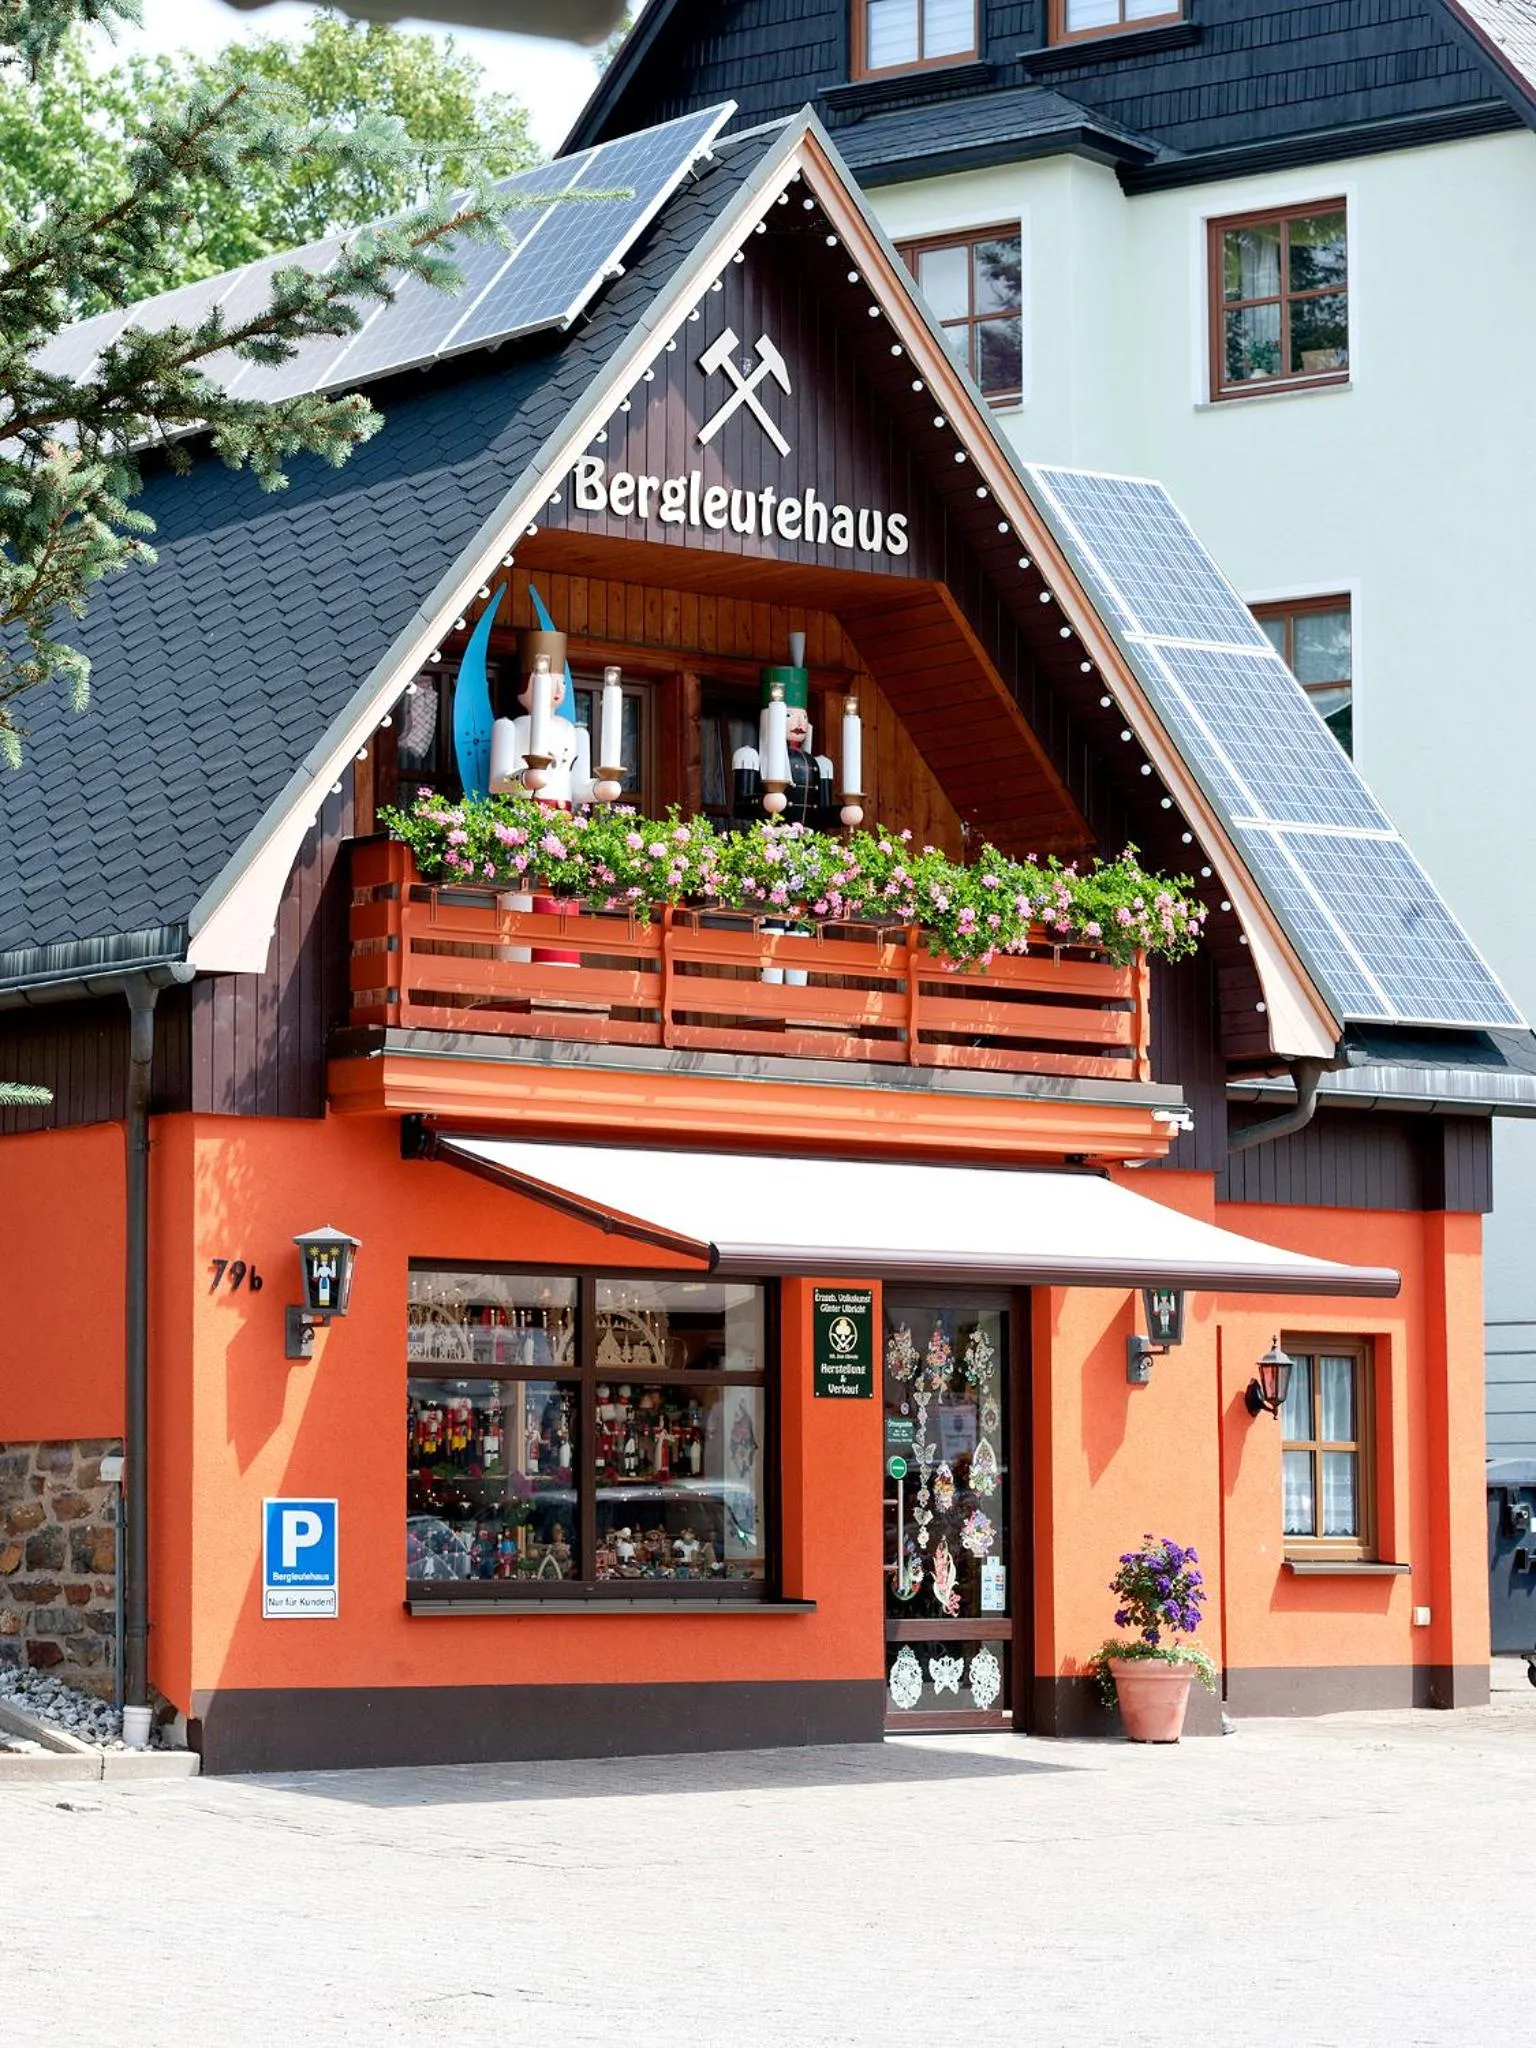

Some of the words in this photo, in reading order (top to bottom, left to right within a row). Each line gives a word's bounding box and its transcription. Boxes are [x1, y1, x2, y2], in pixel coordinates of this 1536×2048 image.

[574, 455, 908, 555] Bergleutehaus
[209, 1259, 263, 1294] 79b
[841, 1304, 866, 1314] Ulbricht
[821, 1363, 866, 1375] Herstellung
[840, 1374, 847, 1383] &
[828, 1383, 860, 1395] Verkauf
[282, 1510, 323, 1567] P
[272, 1571, 330, 1583] Bergleutehaus
[268, 1597, 284, 1607] Nur
[285, 1597, 297, 1607] für
[299, 1597, 334, 1607] Kunden!
